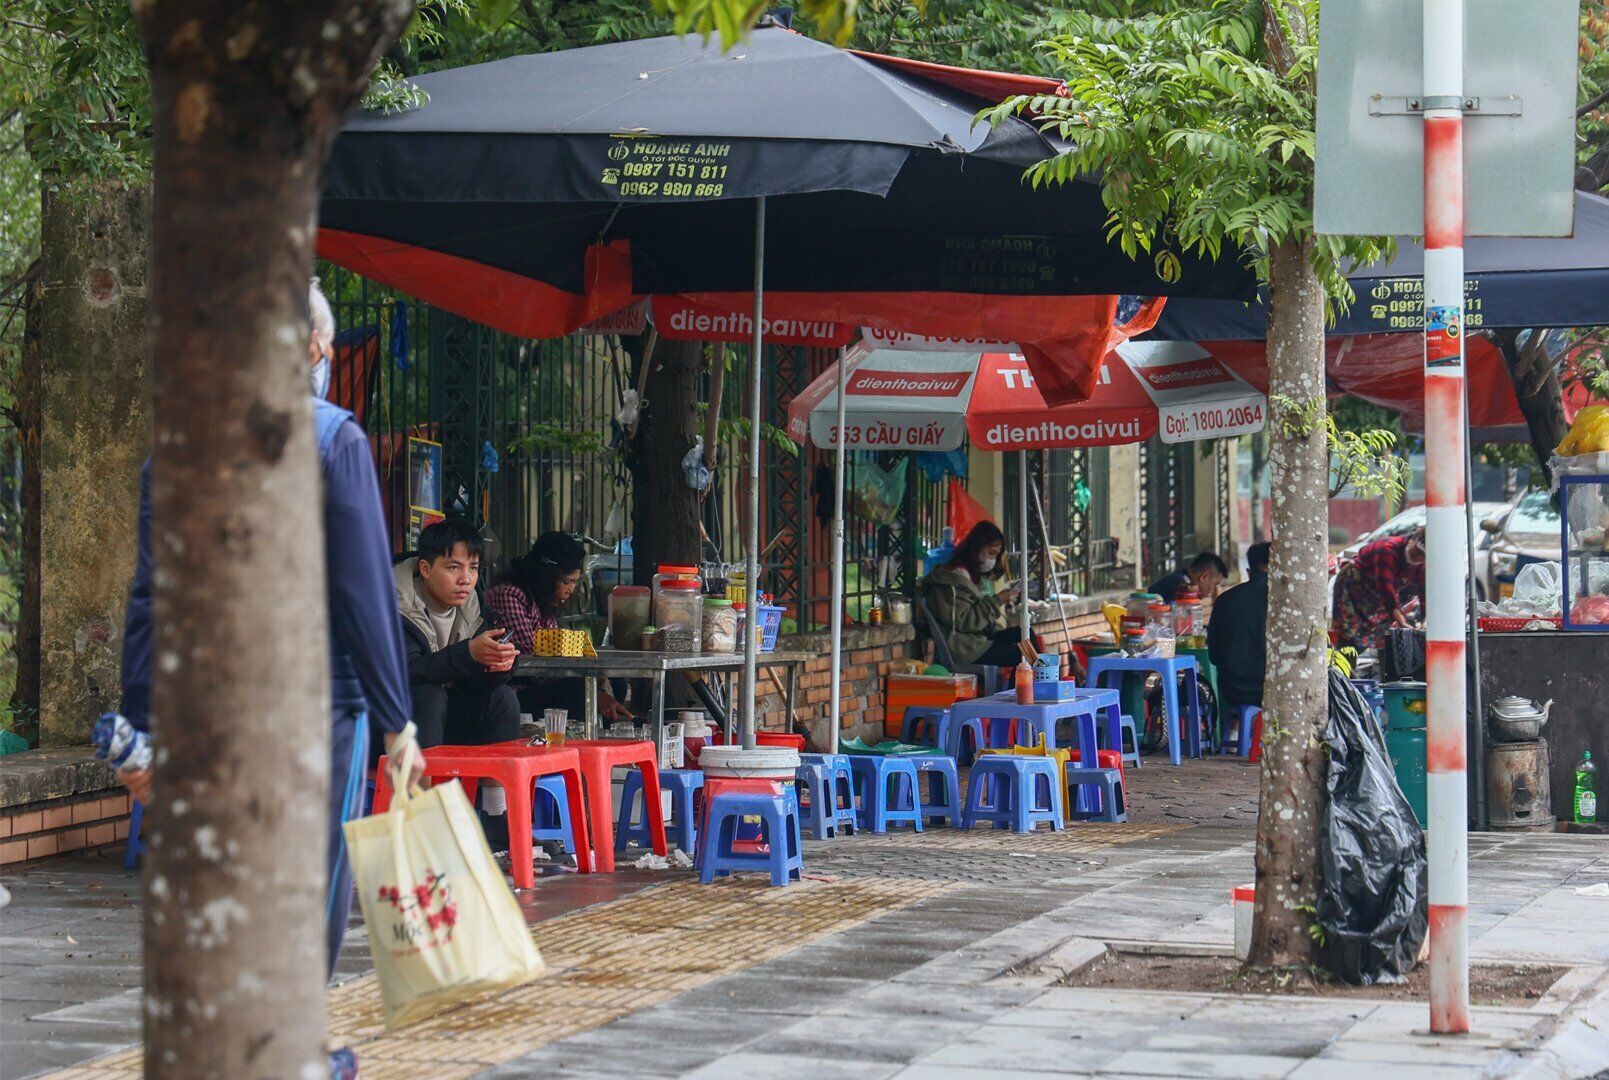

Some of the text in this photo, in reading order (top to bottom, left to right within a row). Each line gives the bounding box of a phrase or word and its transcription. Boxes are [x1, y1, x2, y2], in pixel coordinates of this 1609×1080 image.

[694, 143, 731, 156] ANH
[623, 162, 728, 179] 0987 151 811
[620, 182, 724, 197] 0962 980 868
[1390, 298, 1482, 313] 0987 11
[1390, 314, 1483, 327] 0962 68
[855, 377, 959, 391] dienthoaivui
[997, 367, 1112, 389] THI
[1166, 405, 1262, 438] Gọi: 1800.2064
[865, 421, 901, 445] CẦU
[907, 421, 946, 446] GIẤY
[986, 418, 1141, 444] dienthoaivui
